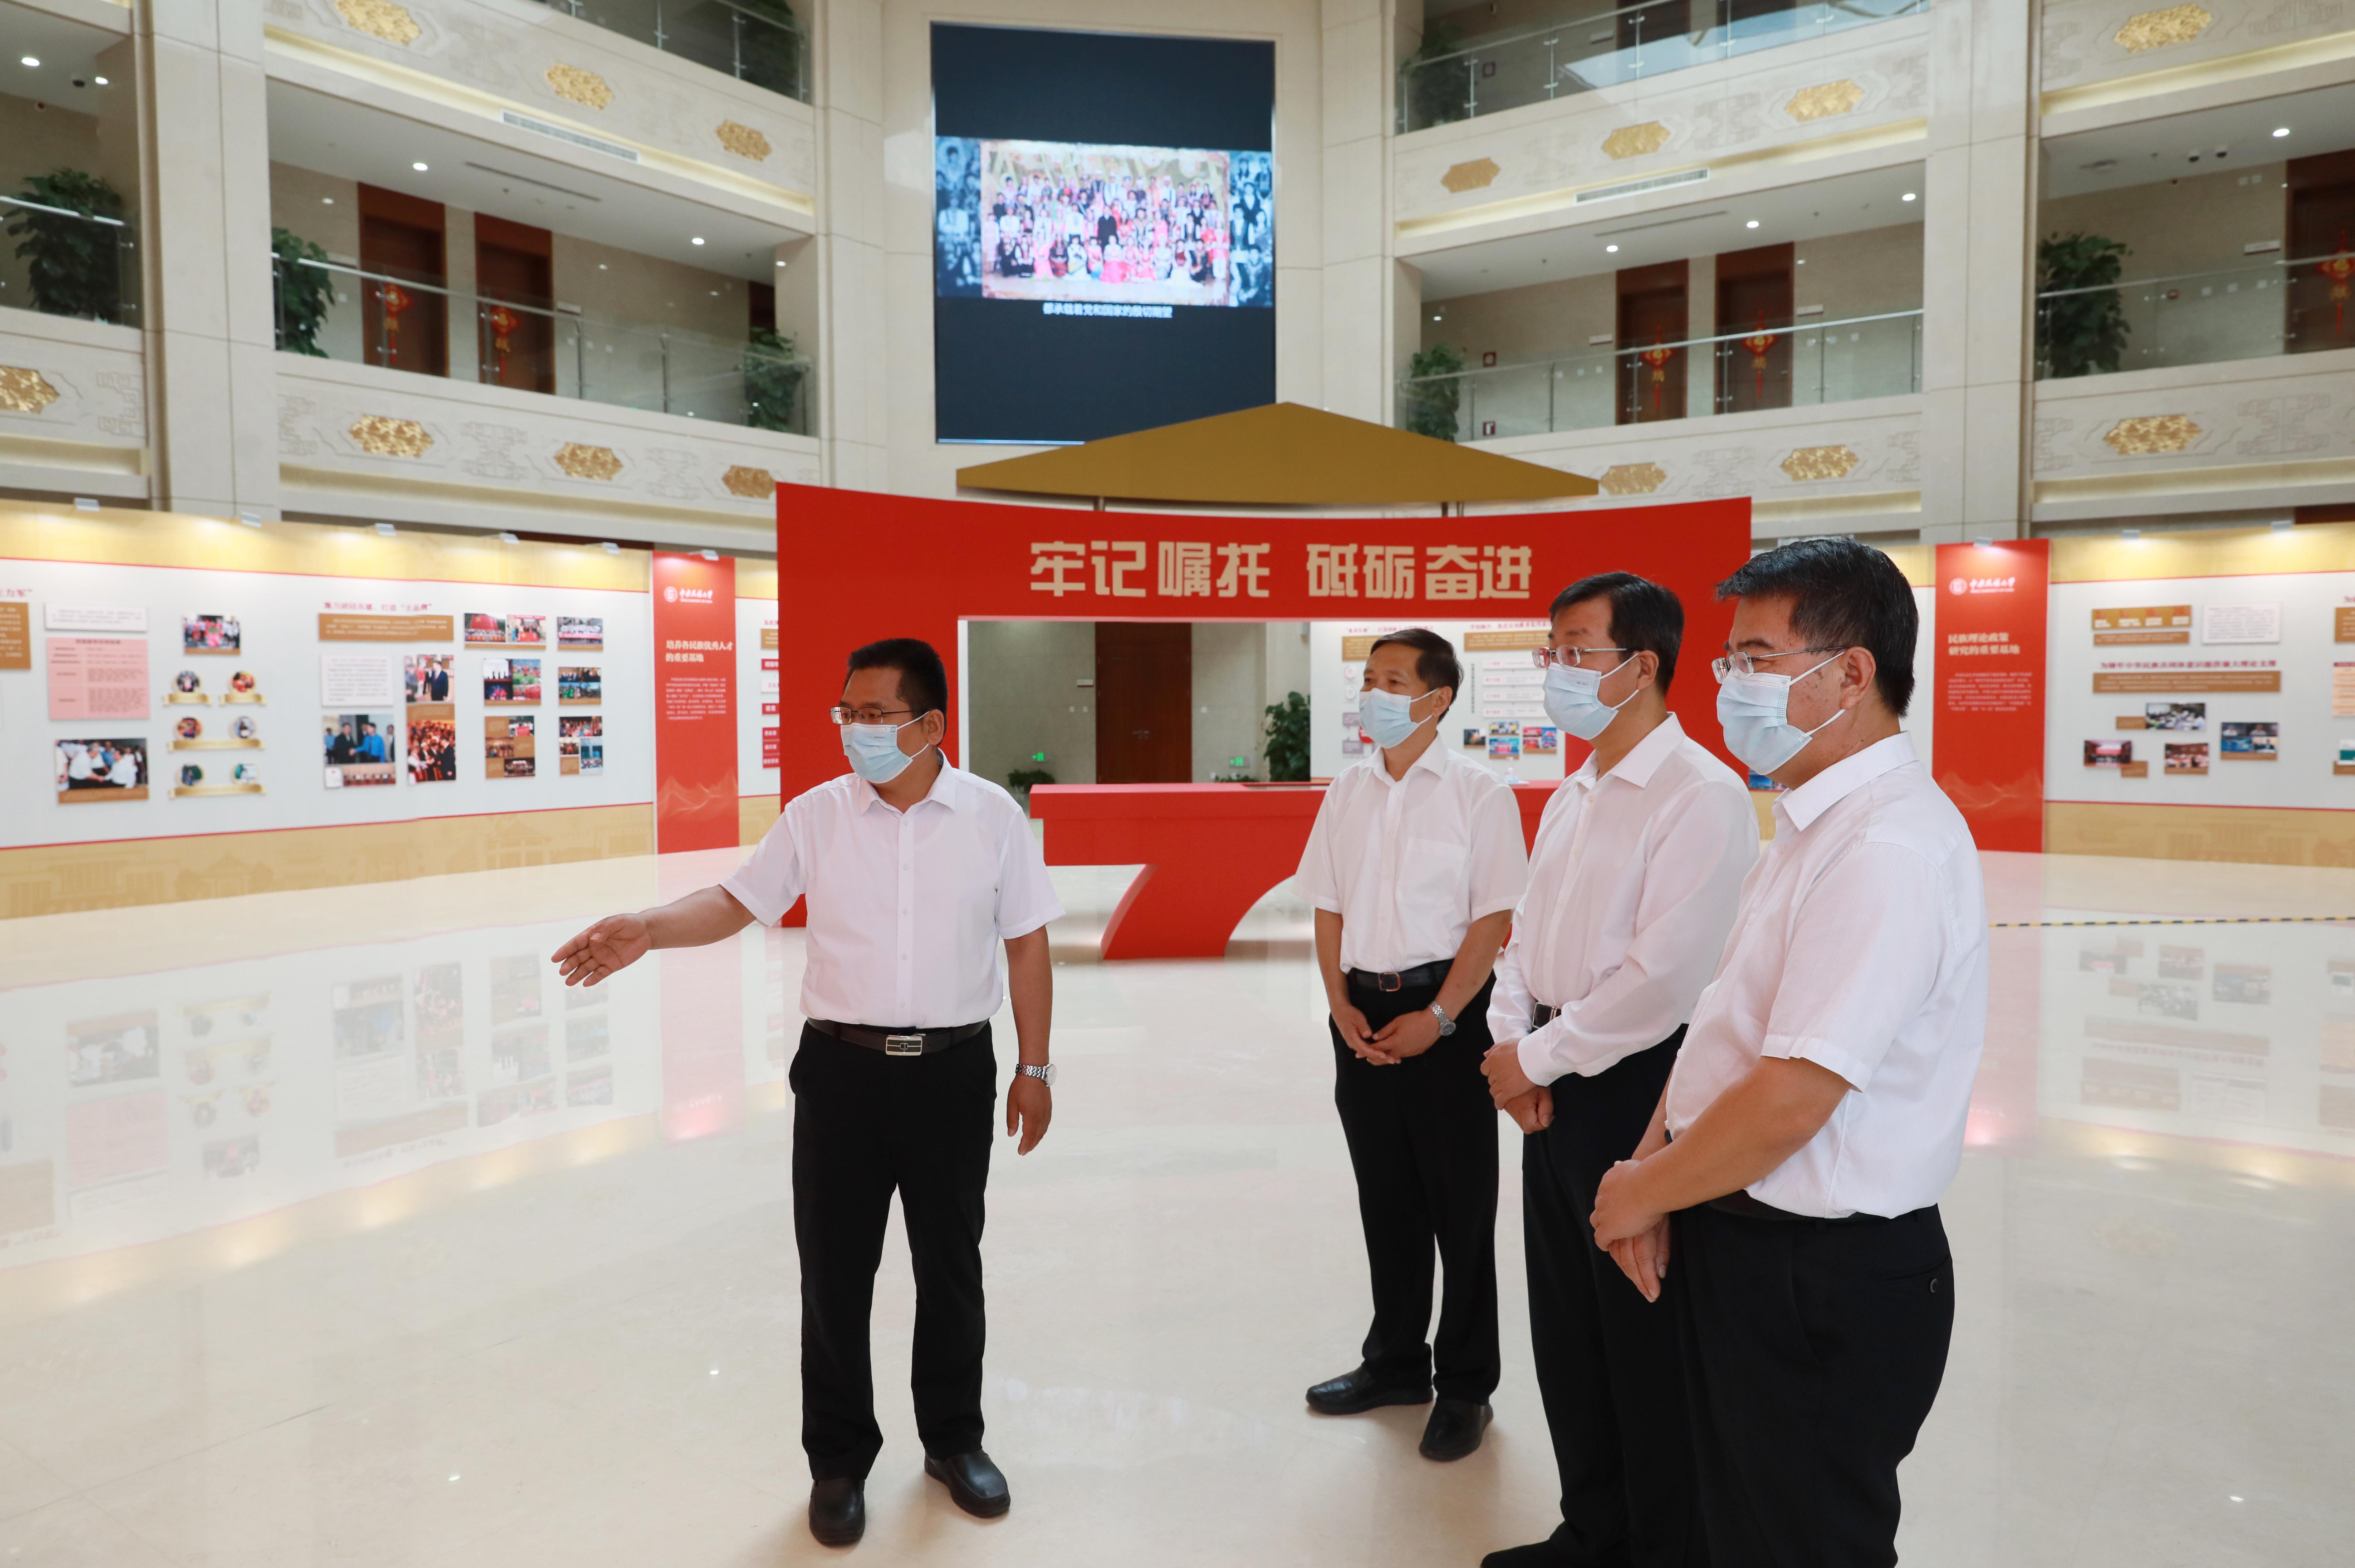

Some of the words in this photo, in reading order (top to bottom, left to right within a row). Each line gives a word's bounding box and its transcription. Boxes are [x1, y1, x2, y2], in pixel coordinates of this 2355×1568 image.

[1043, 302, 1173, 318] 都承载着党和国家的殷切期望
[1030, 541, 1270, 597] 牢记嘱托
[1306, 543, 1532, 600] 砥砺奋进
[1948, 632, 2009, 644] 民族理论政策
[666, 640, 733, 651] 培养各民族优秀人才
[1948, 644, 2021, 656] 研究的重要基地
[665, 653, 704, 663] 的重要基地
